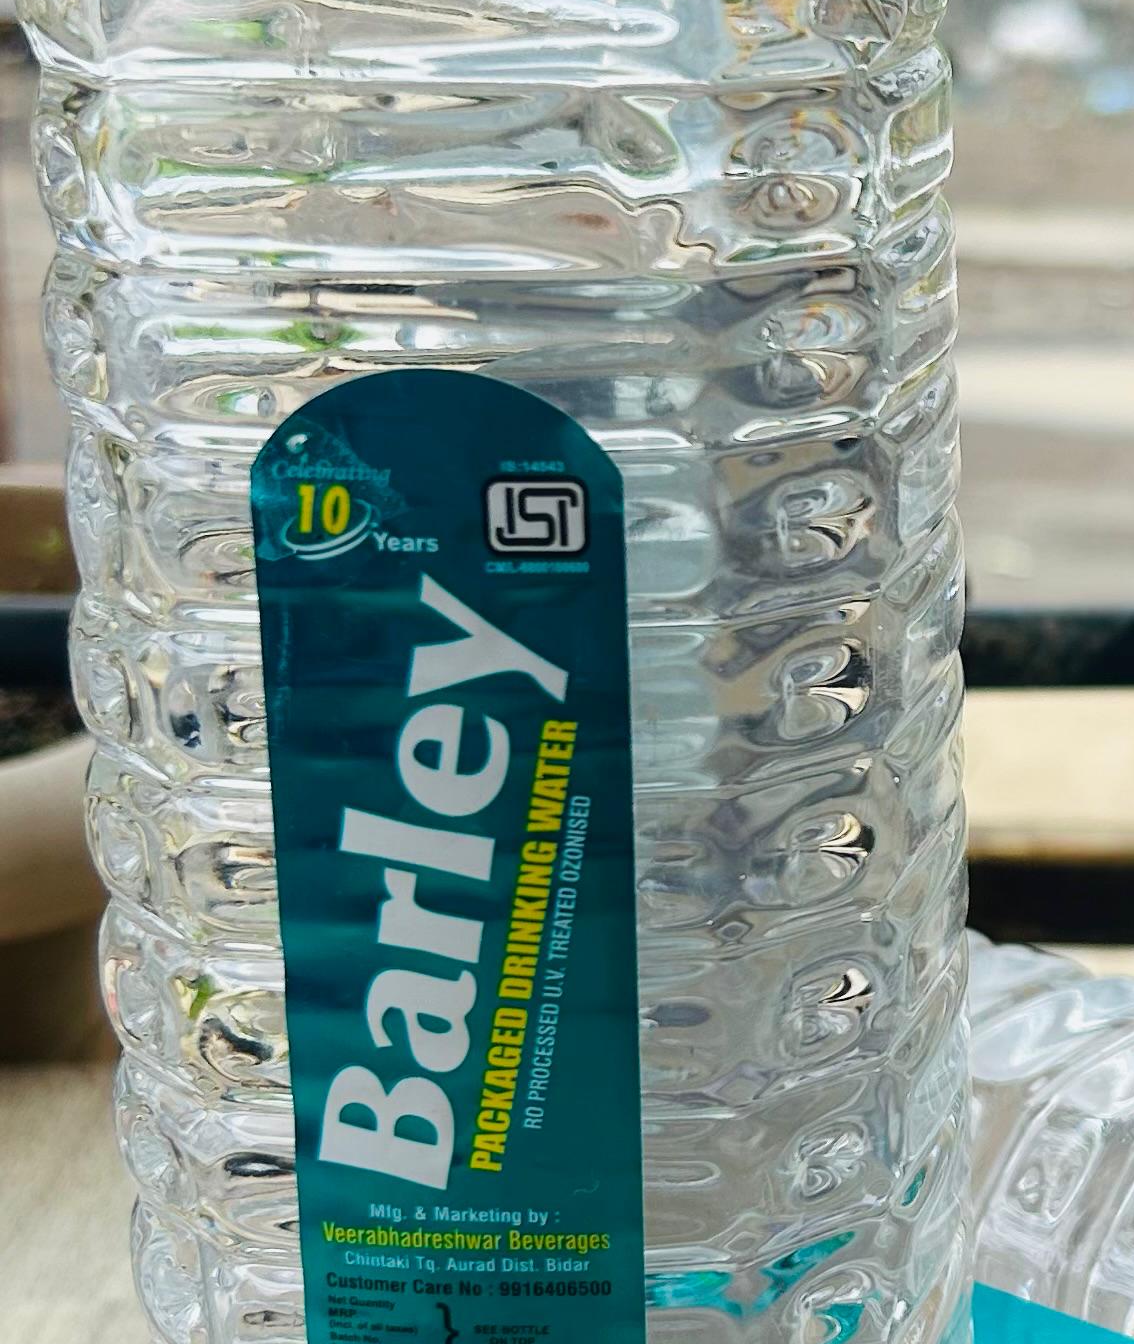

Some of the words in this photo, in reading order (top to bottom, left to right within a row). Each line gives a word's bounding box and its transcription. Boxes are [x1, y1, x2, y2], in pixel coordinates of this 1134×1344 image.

[296, 484, 351, 536] 10
[372, 532, 440, 554] Years
[526, 719, 579, 834] WATER
[561, 795, 592, 883] OZONISED
[318, 573, 570, 1191] Barley
[498, 841, 558, 1001] DRINKING
[547, 886, 578, 961] TREATED
[543, 967, 568, 998] U.V.
[527, 1003, 559, 1101] PROCESSED
[470, 1007, 528, 1173] PACKAGED
[522, 1106, 544, 1129] RO
[322, 1221, 502, 1250] Veerabhadreshwar
[508, 1229, 611, 1254] Beverages
[415, 1206, 427, 1220] &
[434, 1206, 522, 1225] Marketing
[326, 1272, 407, 1295] Customer
[413, 1279, 452, 1296] Care
[447, 1257, 496, 1272] Aurad
[546, 1258, 591, 1272] Bidar
